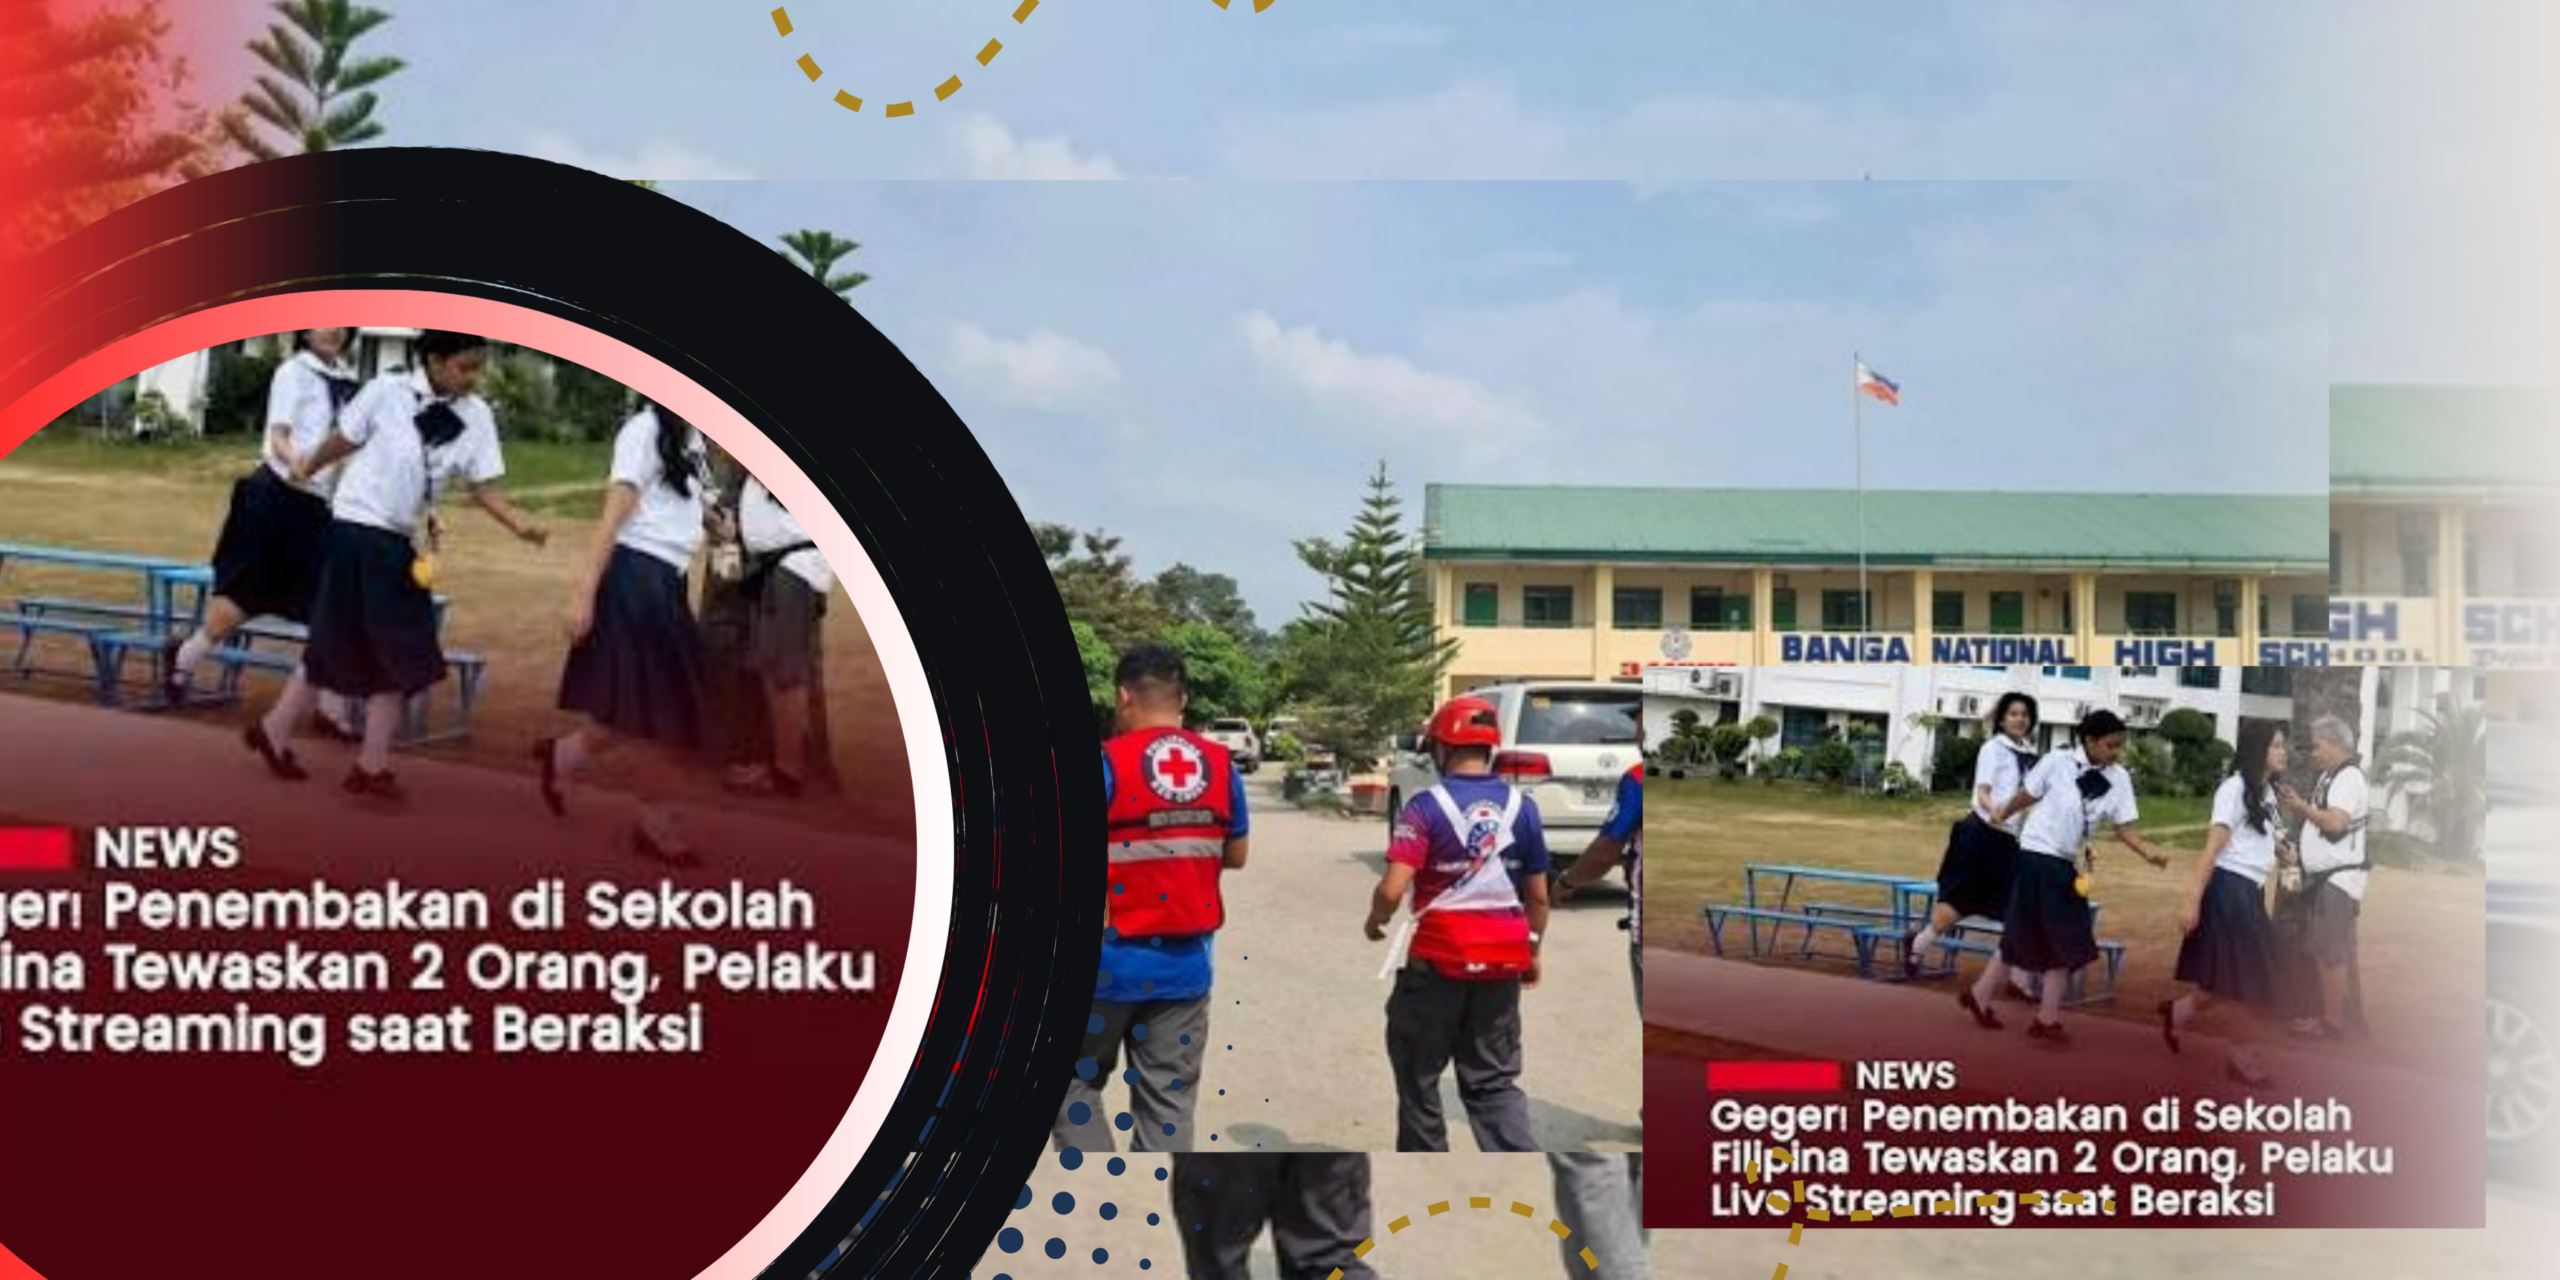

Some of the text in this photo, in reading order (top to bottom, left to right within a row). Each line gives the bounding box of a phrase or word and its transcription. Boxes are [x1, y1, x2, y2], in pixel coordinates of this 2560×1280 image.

[1782, 636, 2329, 666] BANGA NATIONAL HIGH SCH
